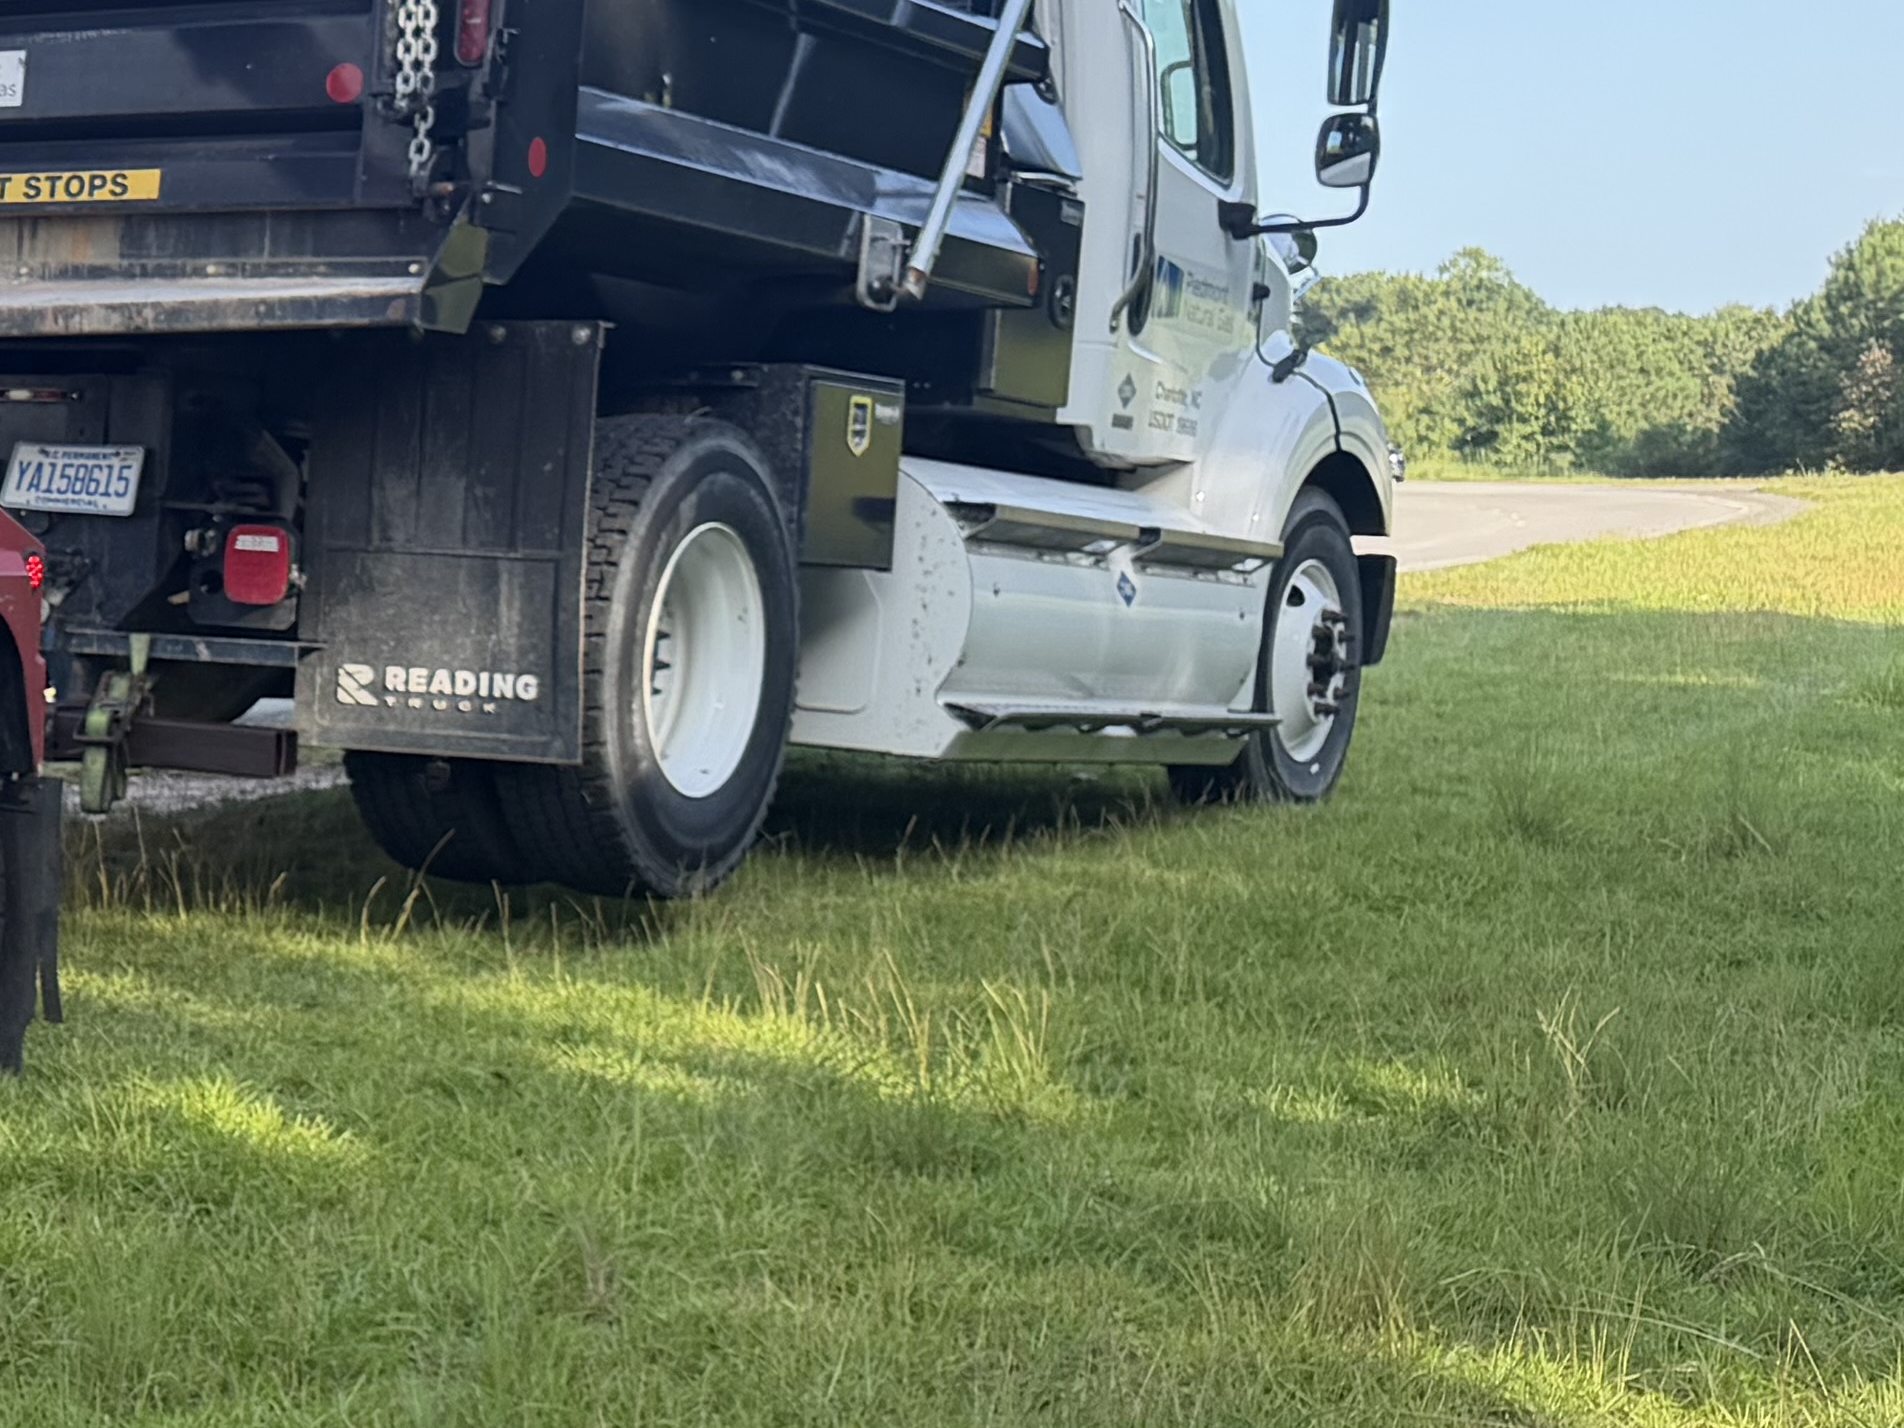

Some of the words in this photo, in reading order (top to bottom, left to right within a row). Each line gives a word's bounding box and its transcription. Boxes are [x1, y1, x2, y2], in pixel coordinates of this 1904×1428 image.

[22, 172, 129, 200] STOPS
[15, 460, 132, 498] YA158615
[385, 665, 538, 700] READING
